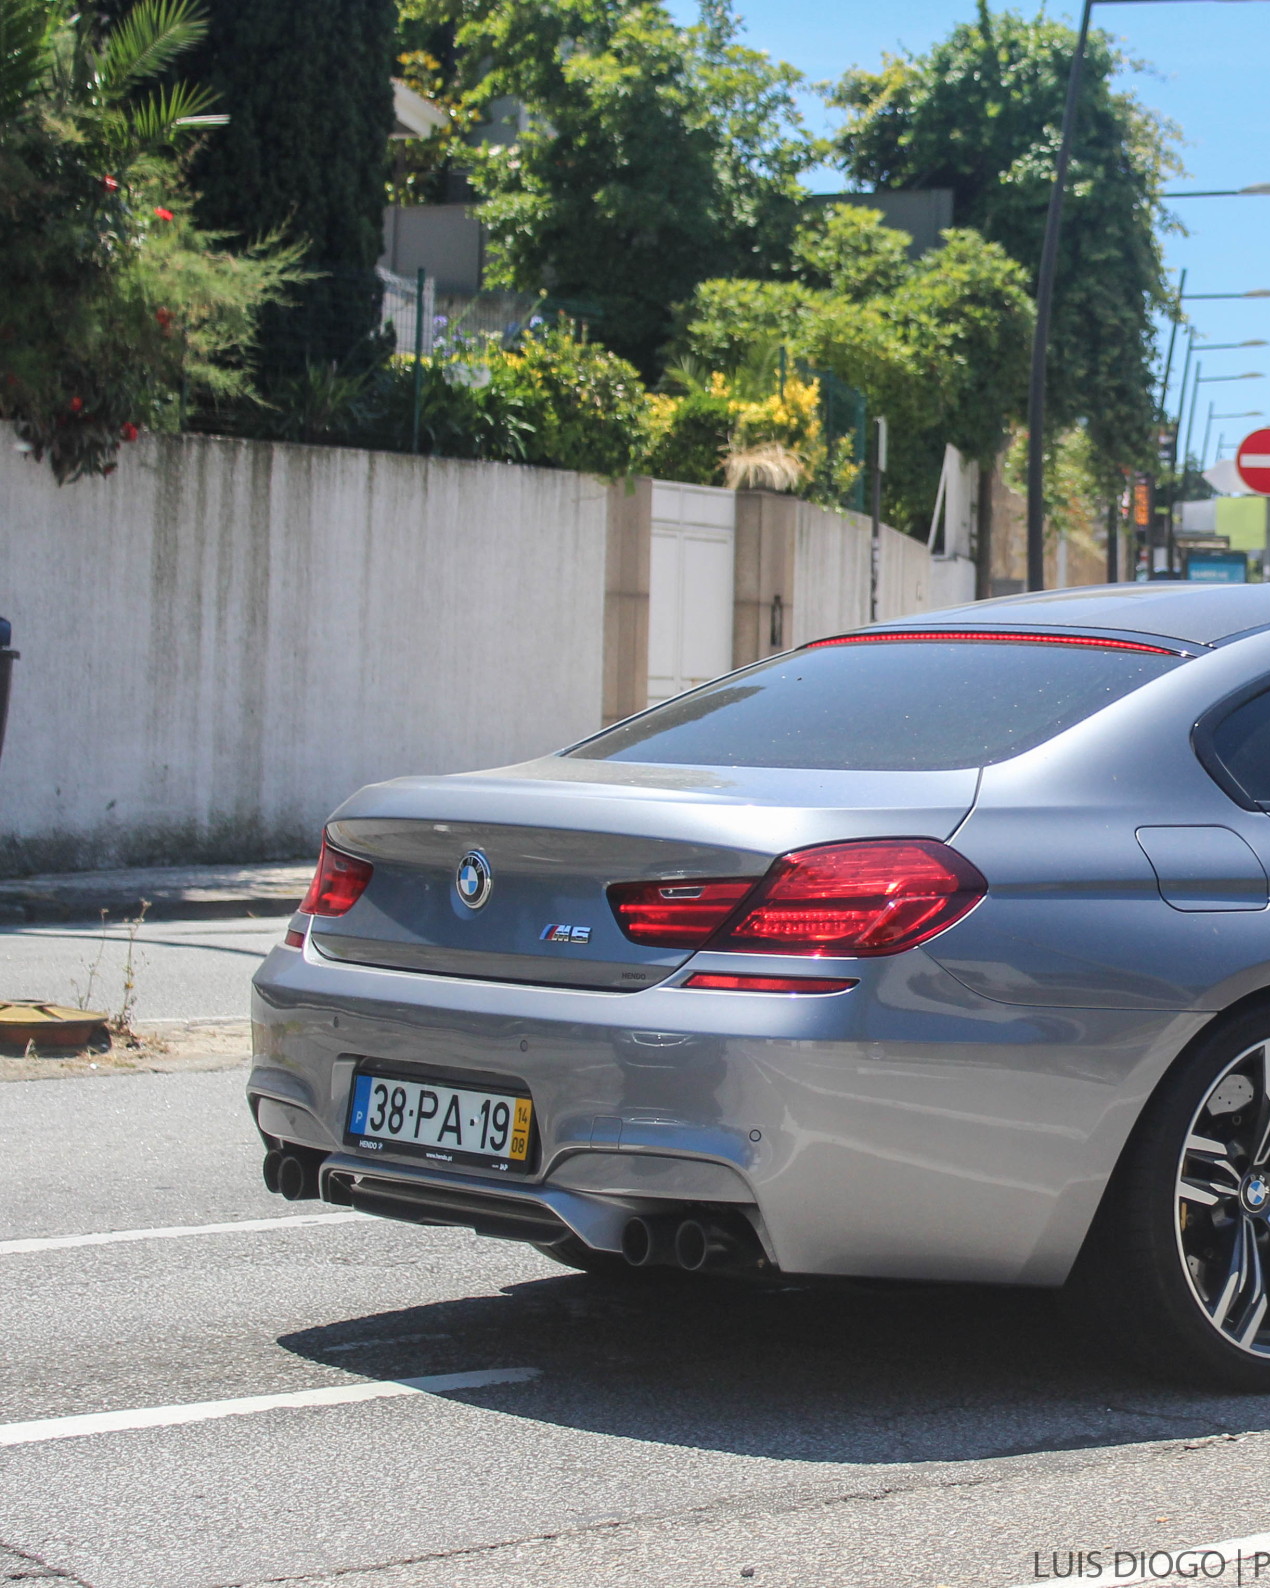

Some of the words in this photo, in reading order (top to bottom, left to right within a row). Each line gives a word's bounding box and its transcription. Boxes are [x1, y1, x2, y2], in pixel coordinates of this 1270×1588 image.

[551, 924, 591, 944] M6
[355, 1110, 363, 1124] P
[518, 1106, 528, 1124] 14
[359, 1140, 377, 1150] HENDO
[511, 1136, 525, 1154] 08
